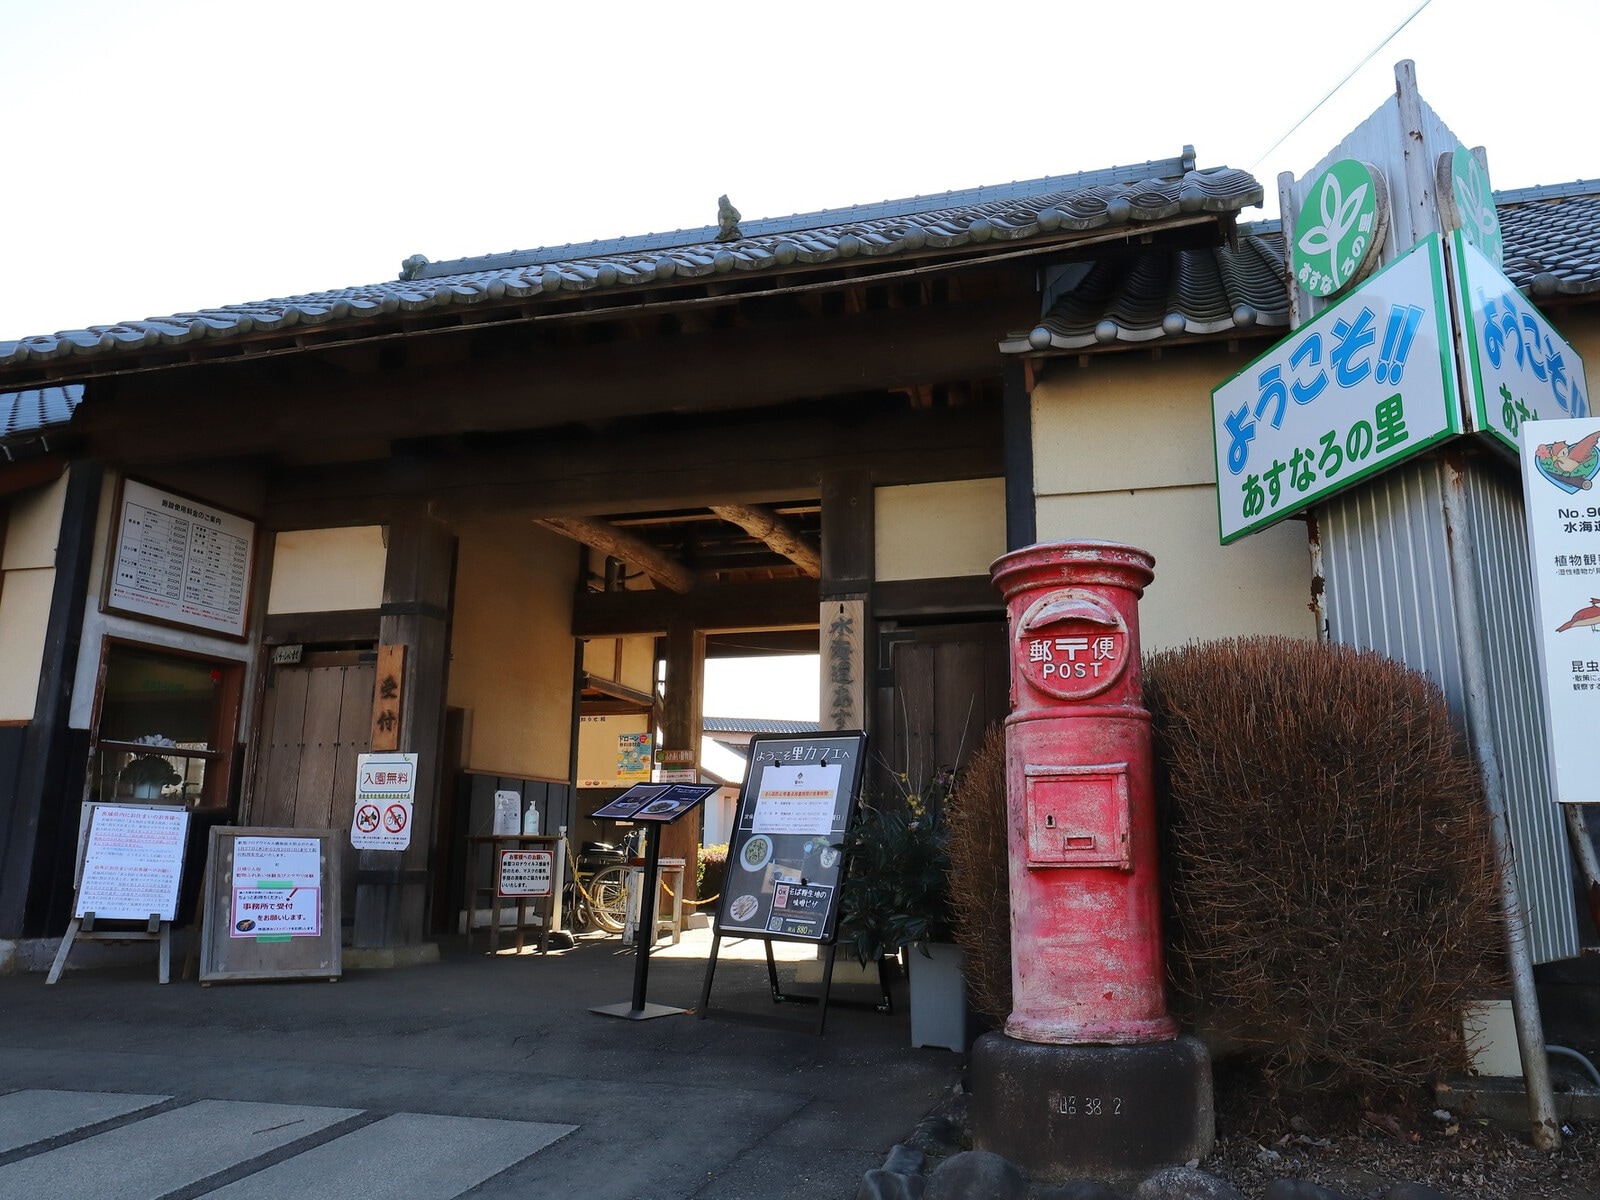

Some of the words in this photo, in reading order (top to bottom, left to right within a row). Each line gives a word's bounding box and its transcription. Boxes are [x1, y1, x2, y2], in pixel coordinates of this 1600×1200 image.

[1224, 304, 1425, 476] ようこそ!!
[1241, 392, 1409, 518] あすなろの里
[1558, 507, 1600, 519] No.9
[1555, 554, 1600, 567] 植物観
[1043, 662, 1103, 679] POST
[756, 746, 850, 761] ようこそ里カフェへ
[363, 772, 408, 785] 入園無料
[243, 903, 294, 911] 事務所で受付
[1085, 1097, 1102, 1115] 38
